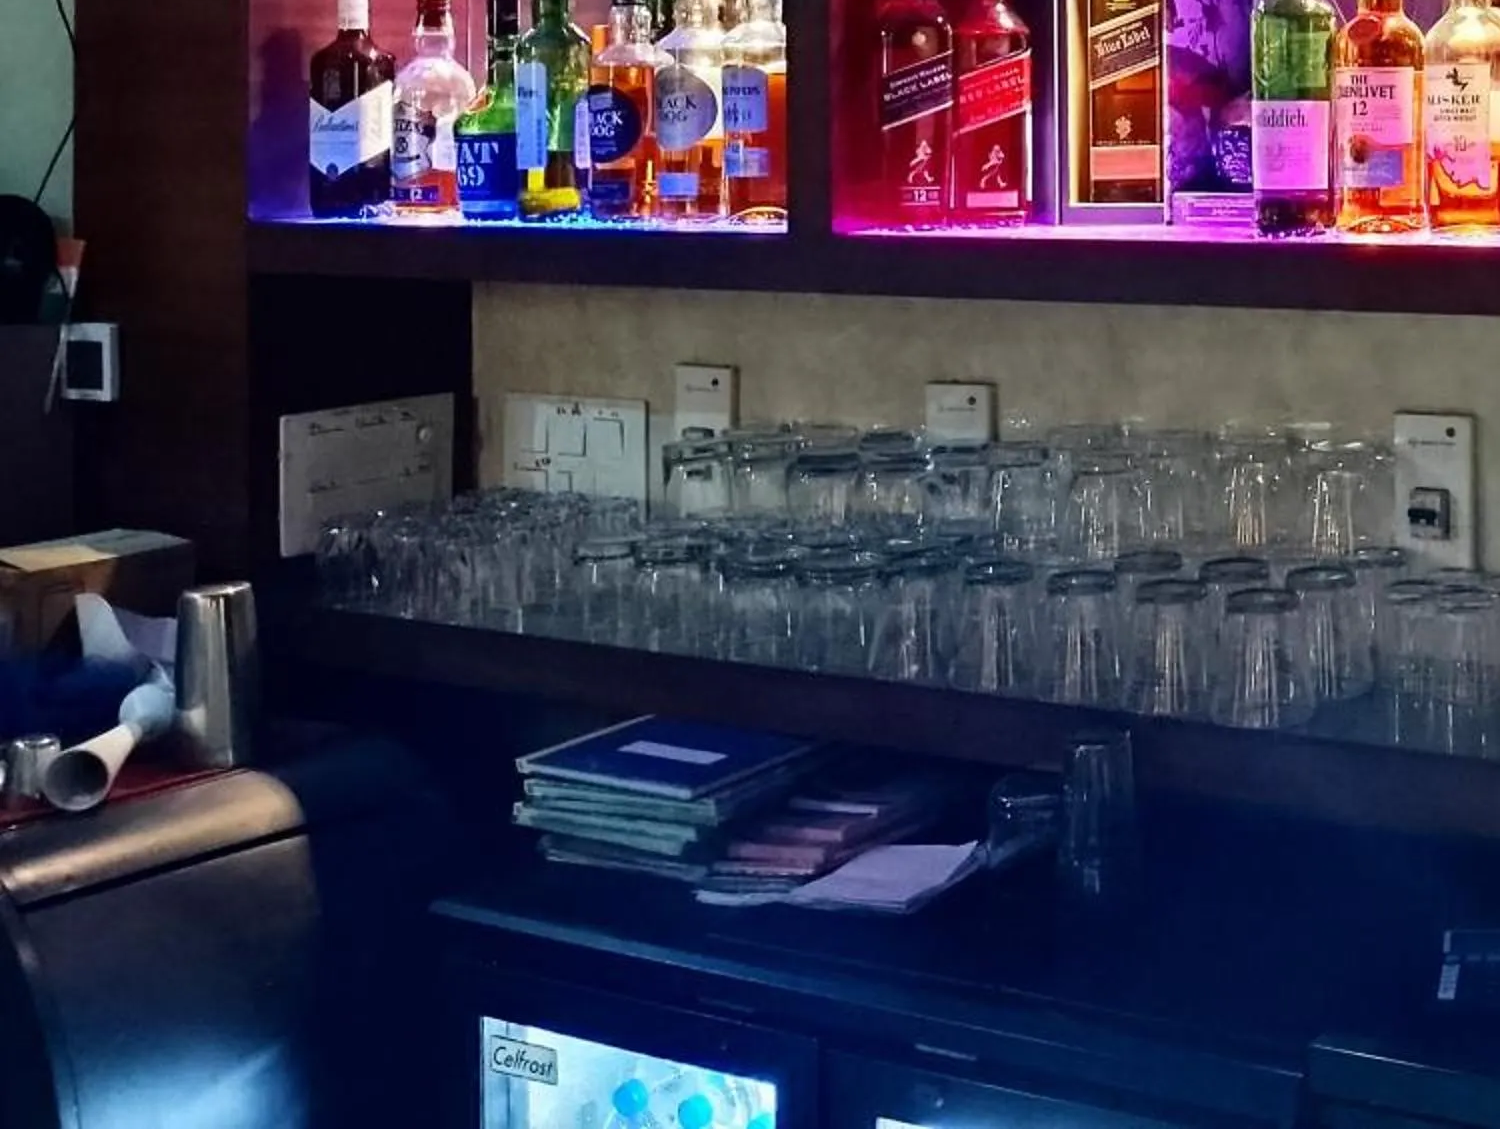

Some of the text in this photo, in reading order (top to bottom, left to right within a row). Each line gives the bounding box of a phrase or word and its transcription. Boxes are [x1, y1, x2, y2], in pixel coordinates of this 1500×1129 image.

[919, 72, 953, 90] LABEL
[1351, 74, 1369, 85] THE
[1351, 100, 1368, 117] 12
[457, 165, 485, 187] 69
[913, 190, 927, 202] 12
[493, 1046, 554, 1078] Celfrost
